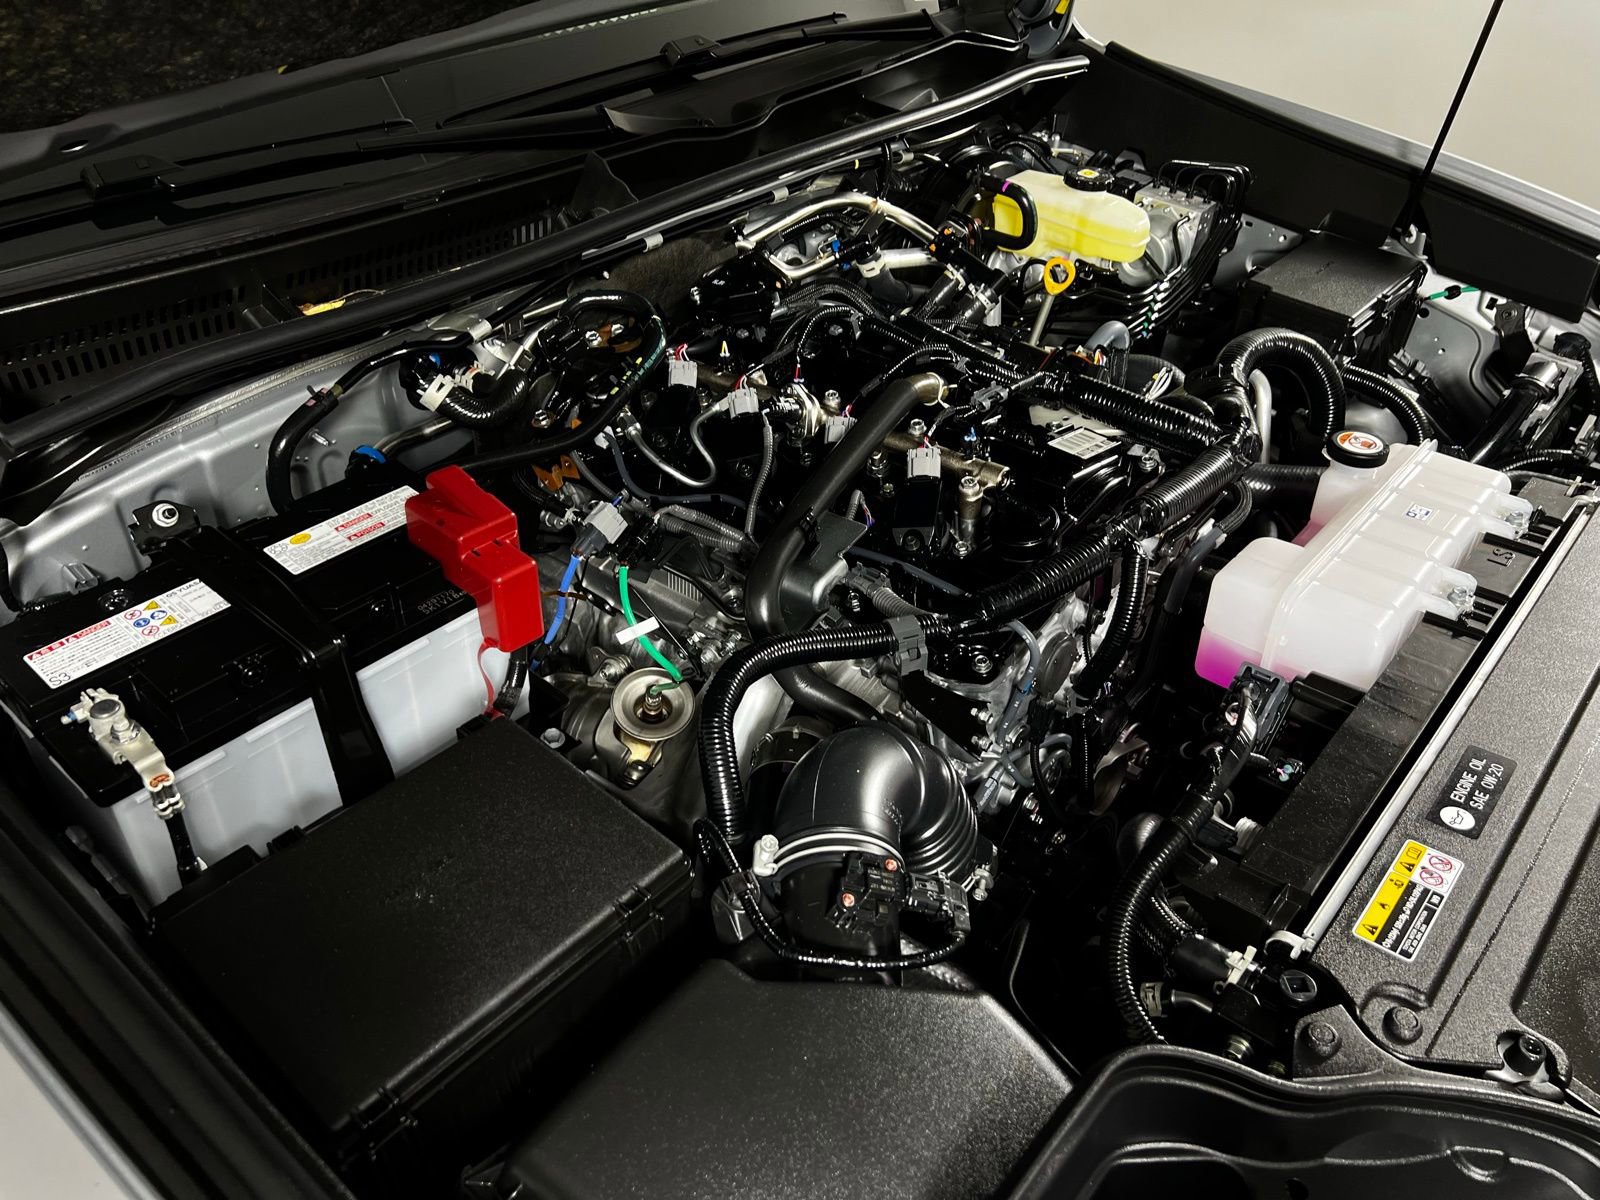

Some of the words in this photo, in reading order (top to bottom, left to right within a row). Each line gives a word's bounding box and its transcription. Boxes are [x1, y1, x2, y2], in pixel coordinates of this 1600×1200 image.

[48, 672, 71, 686] S3
[1450, 771, 1478, 803] ENGINE
[1468, 757, 1487, 771] OIL
[1469, 789, 1490, 810] SAE
